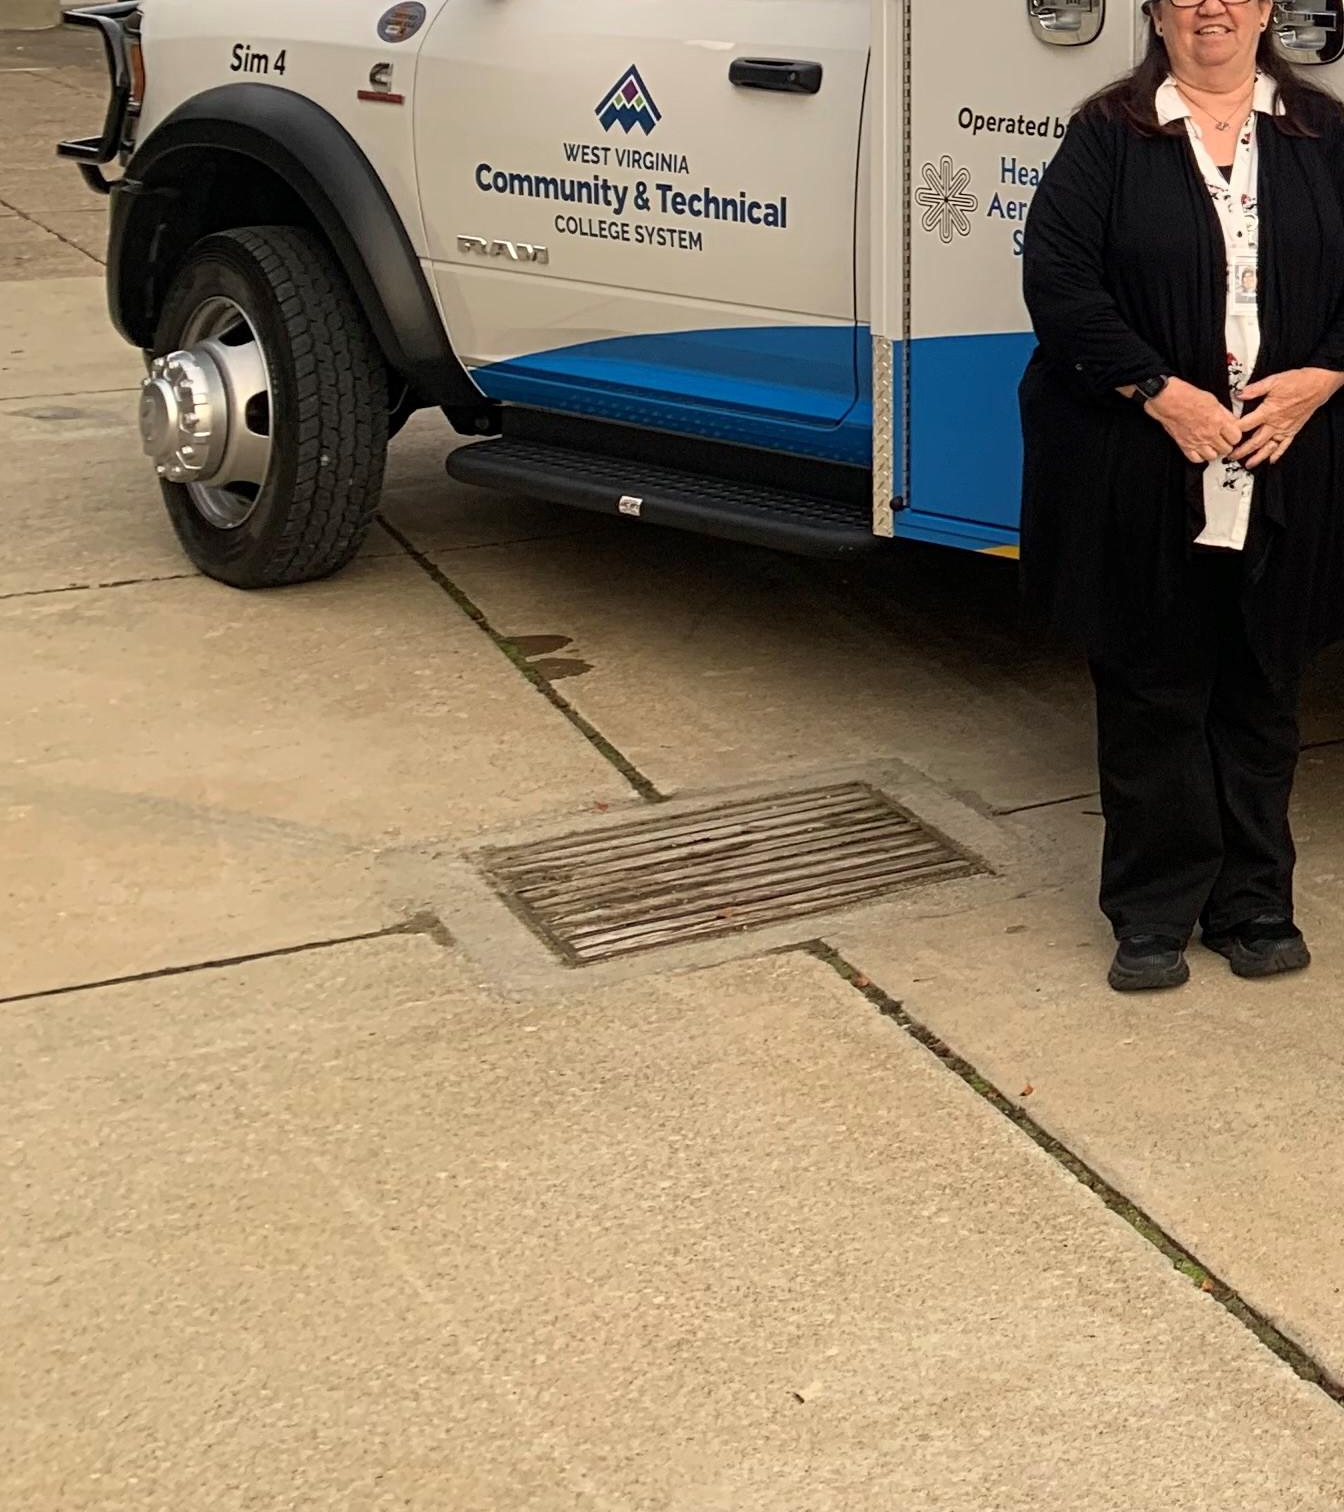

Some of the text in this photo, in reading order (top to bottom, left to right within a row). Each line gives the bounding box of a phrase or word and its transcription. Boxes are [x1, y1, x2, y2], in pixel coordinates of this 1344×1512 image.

[230, 43, 286, 76] Sim 4
[958, 107, 1067, 139] Operated b
[563, 142, 690, 175] WEST VIRGINIA
[475, 163, 788, 229] Community & Technical
[456, 234, 550, 265] RAM
[554, 215, 704, 252] COLLEGE SYSTEM
